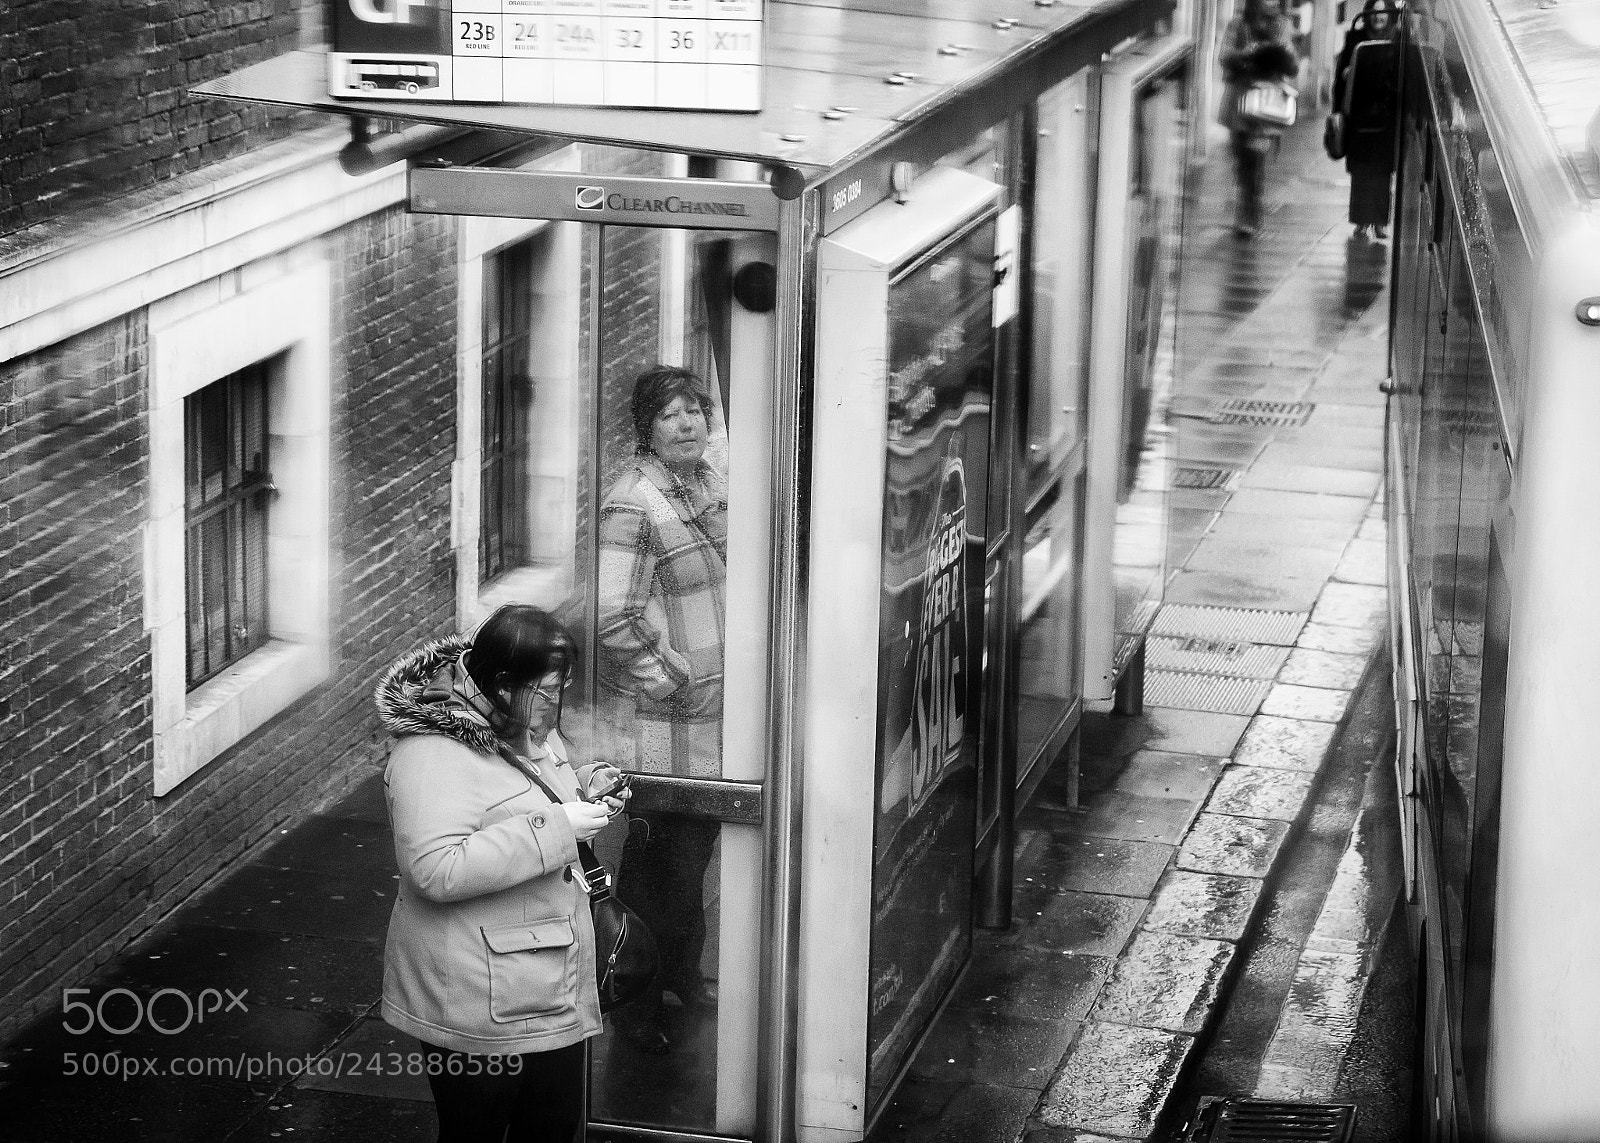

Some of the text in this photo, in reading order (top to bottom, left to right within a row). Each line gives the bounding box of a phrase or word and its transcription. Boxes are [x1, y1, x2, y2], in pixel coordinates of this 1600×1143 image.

[460, 21, 495, 41] 23B
[514, 22, 538, 41] 24
[615, 28, 644, 49] 32
[670, 30, 694, 49] 36
[714, 31, 752, 51] X11
